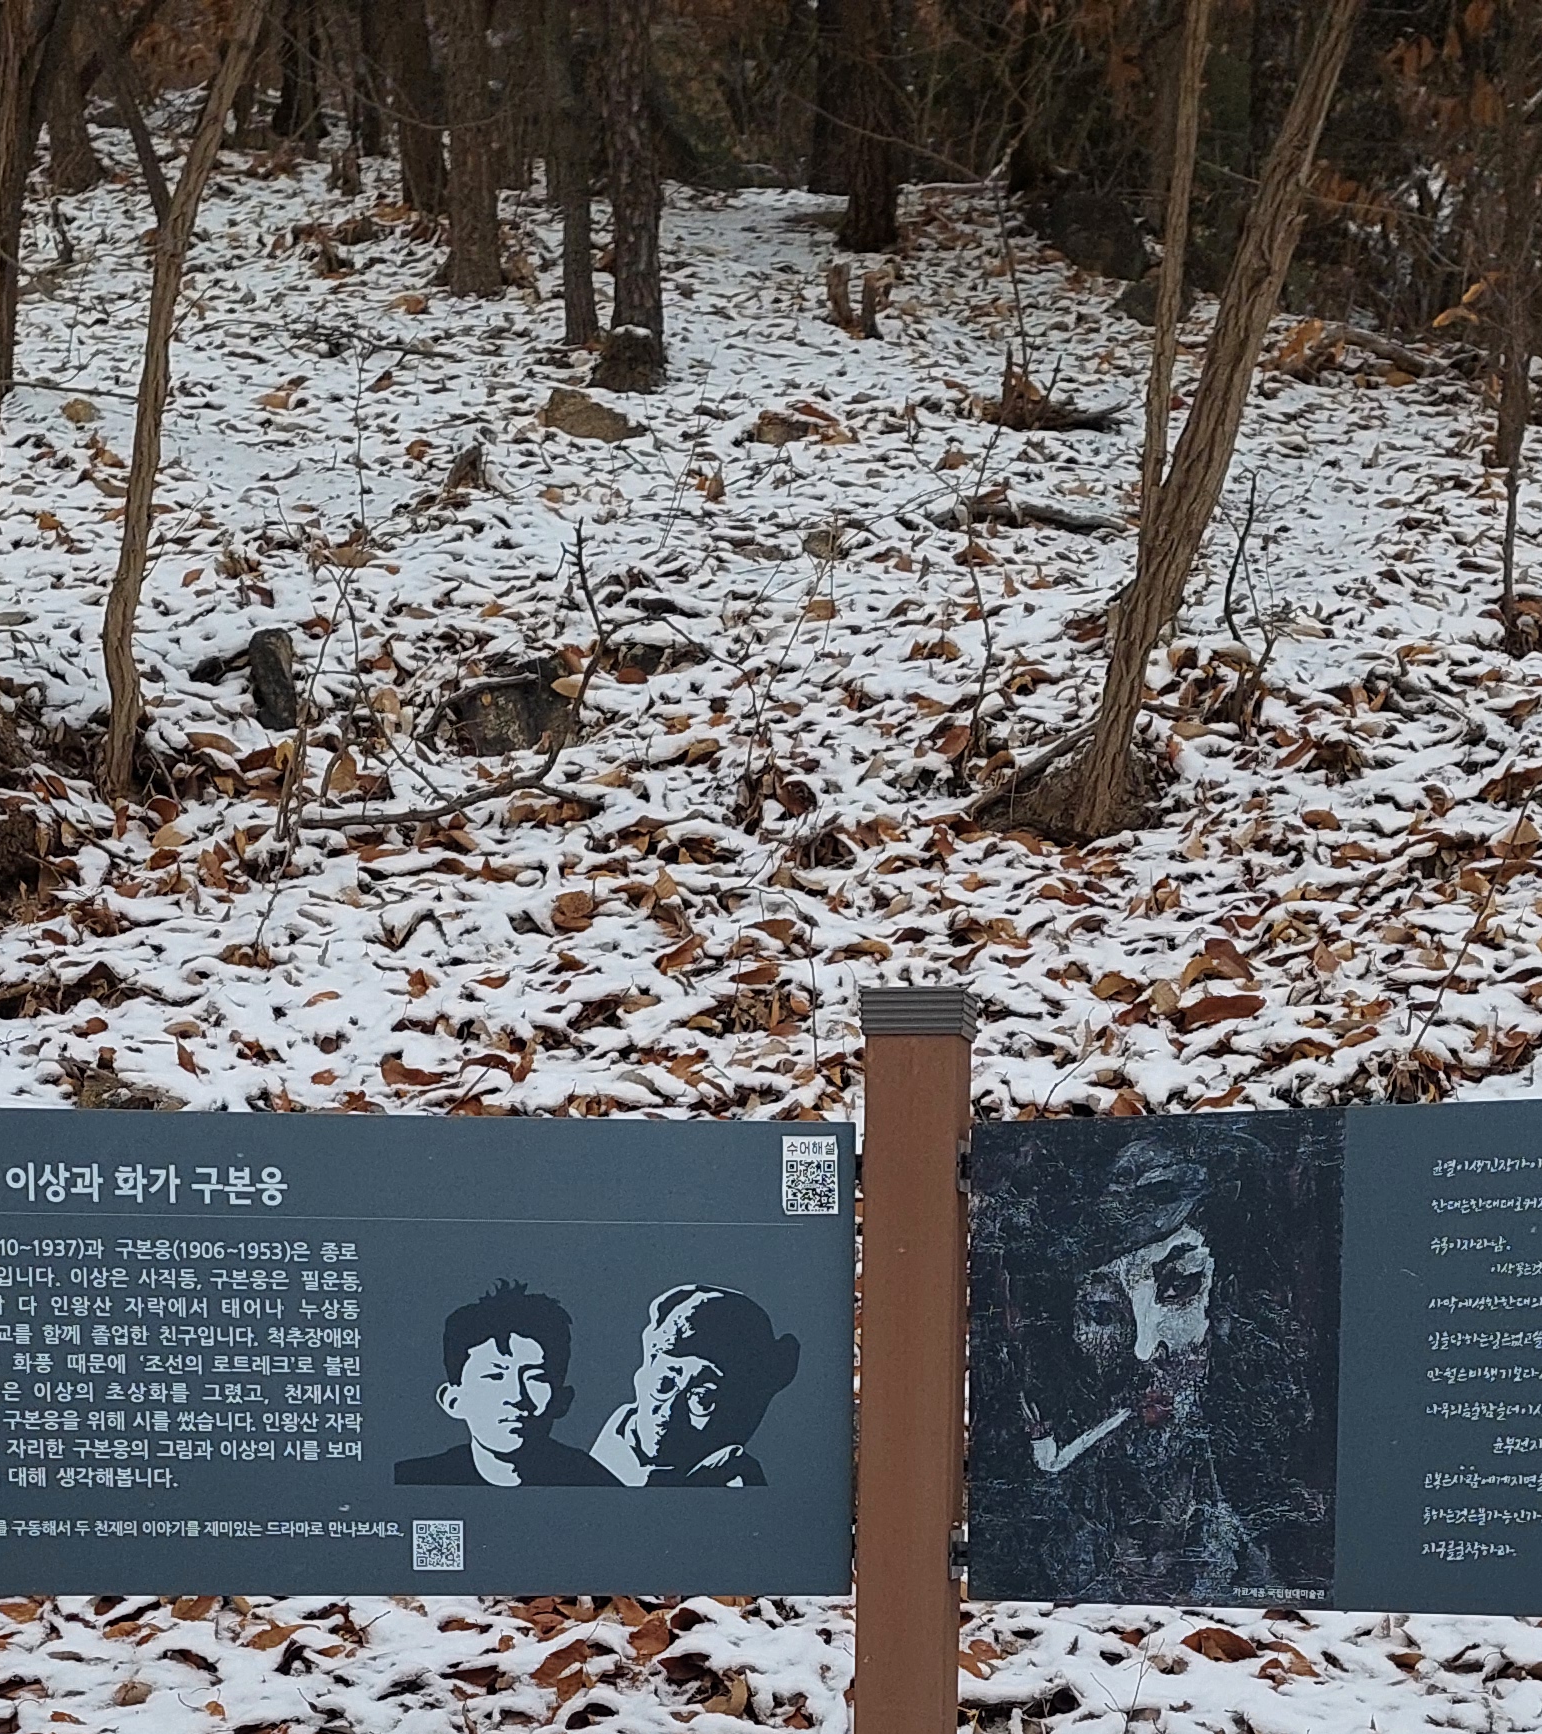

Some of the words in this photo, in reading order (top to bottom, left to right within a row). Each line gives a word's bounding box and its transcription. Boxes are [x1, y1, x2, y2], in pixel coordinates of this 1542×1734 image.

[786, 1141, 836, 1157] 수어해설
[5, 1161, 104, 1203] 이상과
[114, 1163, 181, 1204] 화가
[190, 1166, 288, 1207] 구본웅
[114, 1239, 311, 1263] 구본웅(1906~1953)은
[319, 1241, 359, 1263] 종로
[70, 1266, 130, 1289] 이상은
[137, 1267, 202, 1291] 사직동,
[209, 1268, 290, 1291] 구본웅은
[300, 1269, 363, 1293] 필운동,
[18, 1295, 38, 1317] 다
[50, 1295, 113, 1317] 인왕산
[124, 1296, 208, 1319] 자락에서
[221, 1297, 285, 1320] 태어나
[298, 1298, 361, 1321] 누상동
[41, 1323, 81, 1346] 함께
[90, 1324, 151, 1346] 졸업한
[158, 1325, 259, 1348] 친구입니다.
[267, 1326, 362, 1349] 척추장애와
[12, 1352, 54, 1375] 화풍
[67, 1353, 126, 1375] 때문에
[322, 1355, 361, 1377] 불린
[33, 1381, 94, 1403] 이상의
[104, 1382, 191, 1404] 초상화를
[201, 1383, 270, 1405] 그렸고,
[284, 1383, 363, 1405] 천재시인
[2, 1409, 83, 1431] 구본웅을
[86, 1410, 126, 1432] 위해
[132, 1410, 172, 1433] 시를
[176, 1410, 257, 1433] 썼습니다.
[262, 1411, 320, 1433] 인왕산
[324, 1412, 364, 1434] 자락
[6, 1437, 66, 1460] 자리한
[72, 1438, 149, 1461] 구본웅의
[156, 1438, 215, 1461] 그림과
[220, 1439, 275, 1461] 이상의
[283, 1439, 321, 1461] 시를
[325, 1440, 362, 1462] 보며
[8, 1466, 47, 1488] 대해
[55, 1466, 179, 1489] 생각해봅니다.
[10, 1519, 72, 1538] 구동해서
[74, 1519, 92, 1538] 두
[93, 1519, 139, 1538] 천재의
[141, 1520, 203, 1538] 이야기를
[204, 1520, 264, 1538] 재미있는
[265, 1520, 326, 1538] 드라마로
[328, 1520, 405, 1539] 만나보세요.
